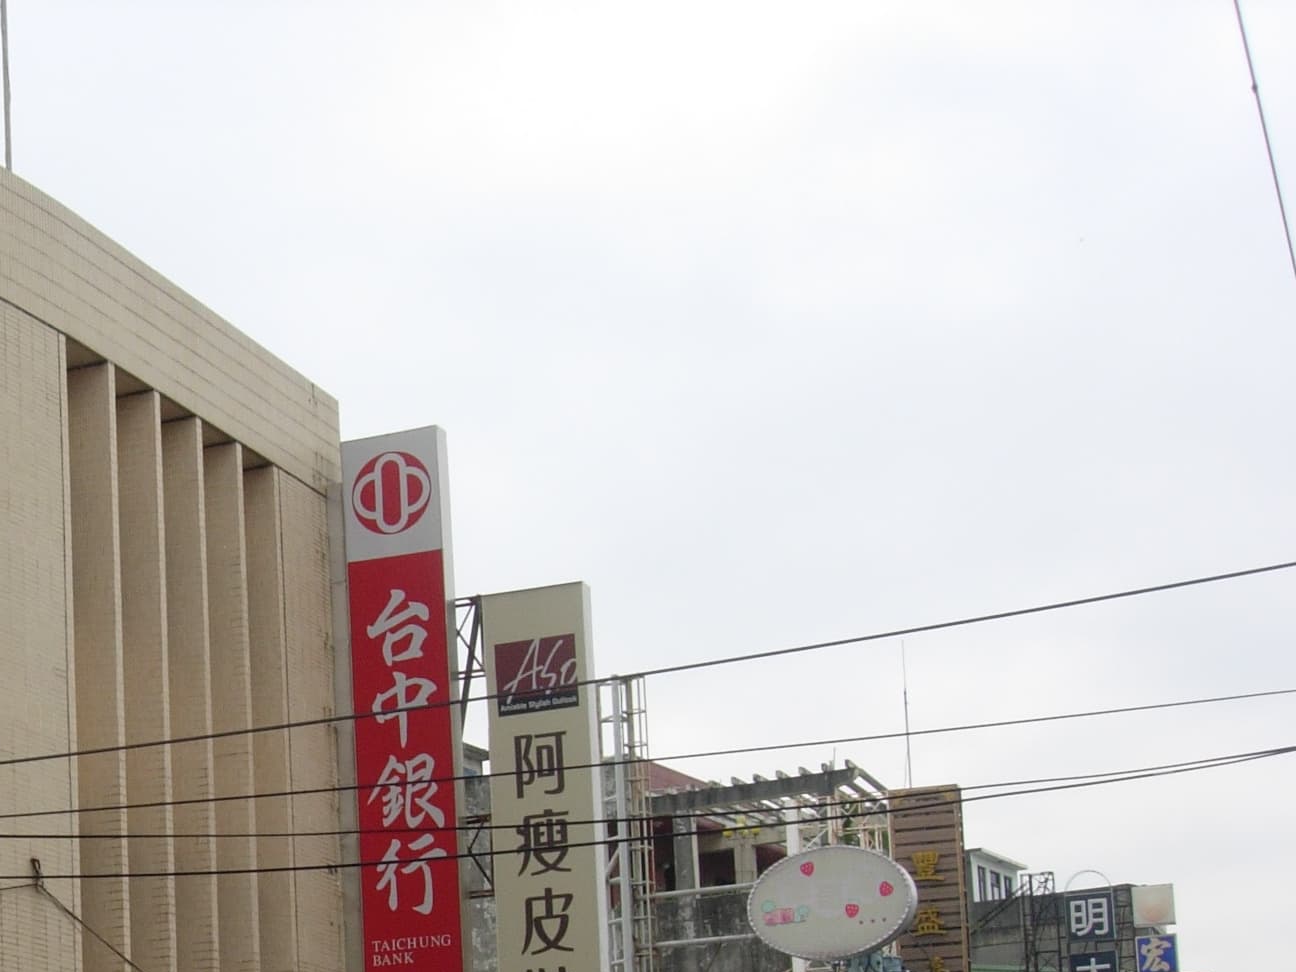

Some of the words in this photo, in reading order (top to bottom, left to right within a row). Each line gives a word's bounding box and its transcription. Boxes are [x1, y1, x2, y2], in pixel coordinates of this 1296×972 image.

[366, 588, 447, 916] 台中銀行
[371, 934, 452, 952] TAICHUNG
[372, 951, 415, 967] BANK
